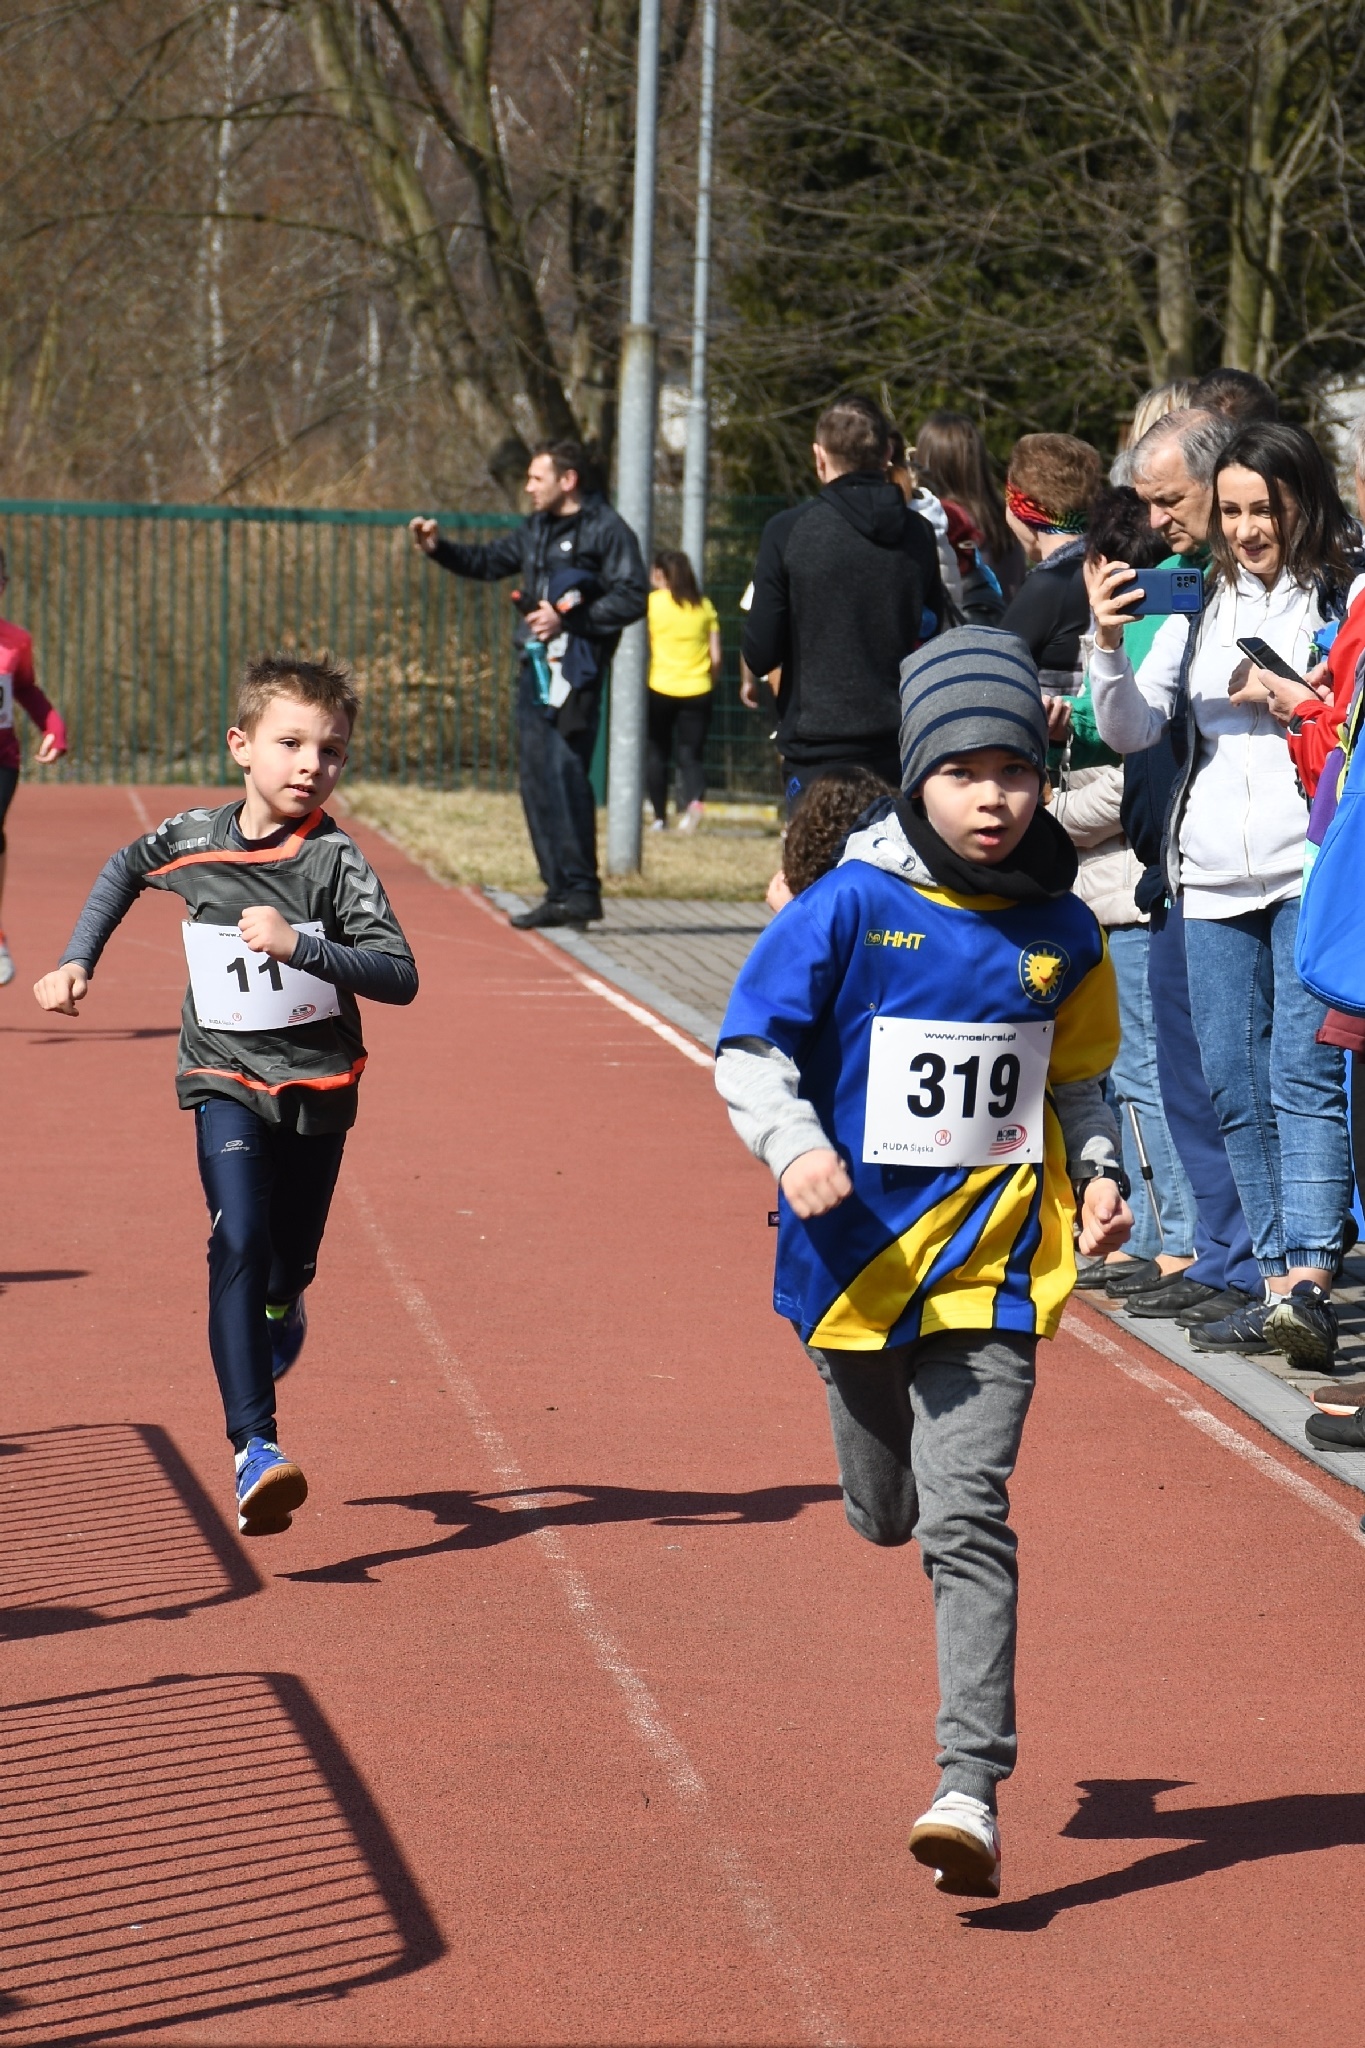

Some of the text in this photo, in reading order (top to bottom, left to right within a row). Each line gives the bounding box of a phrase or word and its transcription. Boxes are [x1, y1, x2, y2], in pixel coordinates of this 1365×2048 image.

[167, 833, 210, 855] hummel
[227, 957, 283, 992] 11
[907, 1052, 1020, 1118] 319
[882, 1142, 934, 1154] RUDA Śląska
